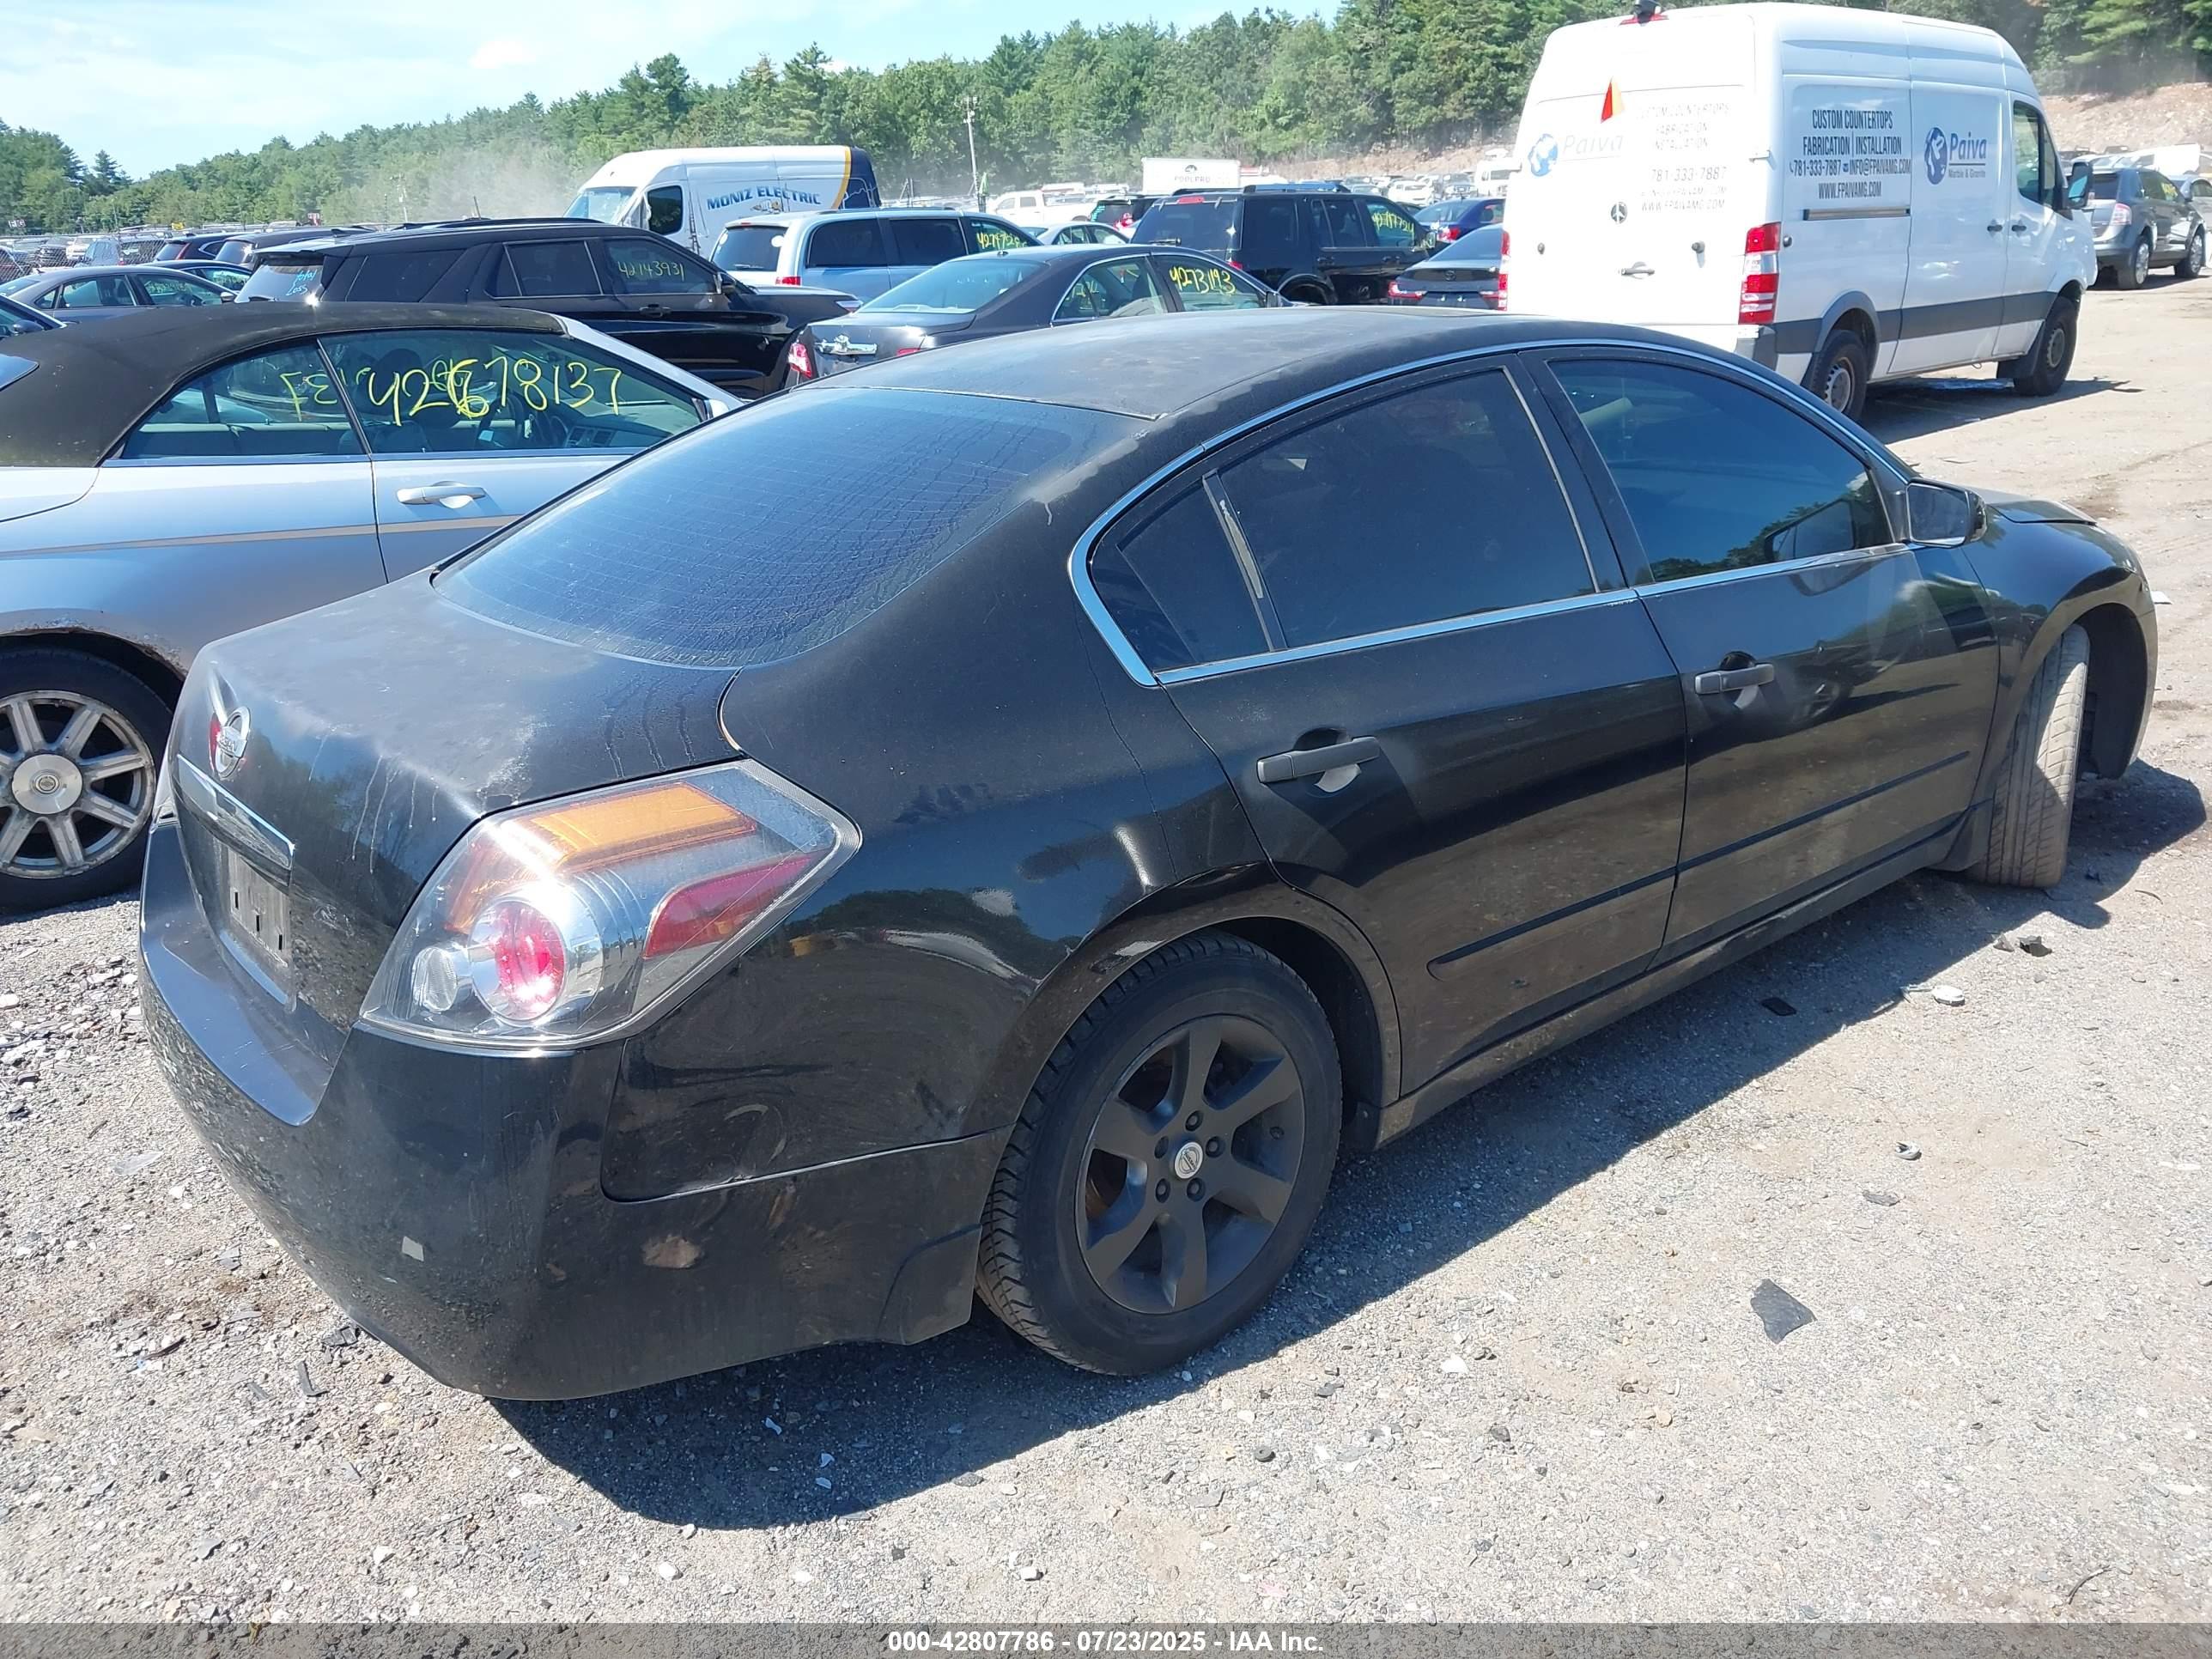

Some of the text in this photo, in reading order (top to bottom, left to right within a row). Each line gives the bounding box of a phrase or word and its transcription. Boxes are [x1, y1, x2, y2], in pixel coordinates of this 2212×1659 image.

[1812, 110, 1893, 130] CUSTOM COUNTERTOPS
[1563, 134, 1624, 155] Paiva
[1803, 136, 1902, 155] FABRICATION INSTALLATION
[1949, 131, 1988, 160] Paiva
[1651, 166, 1727, 182] 781-333-7887
[1793, 158, 1911, 177] 781-333-7887 INFO@FPAIVAMG.COM
[707, 185, 822, 211] MONIZ ELECTRIC
[1819, 181, 1882, 200] WWW.FPAIVAMG.COM
